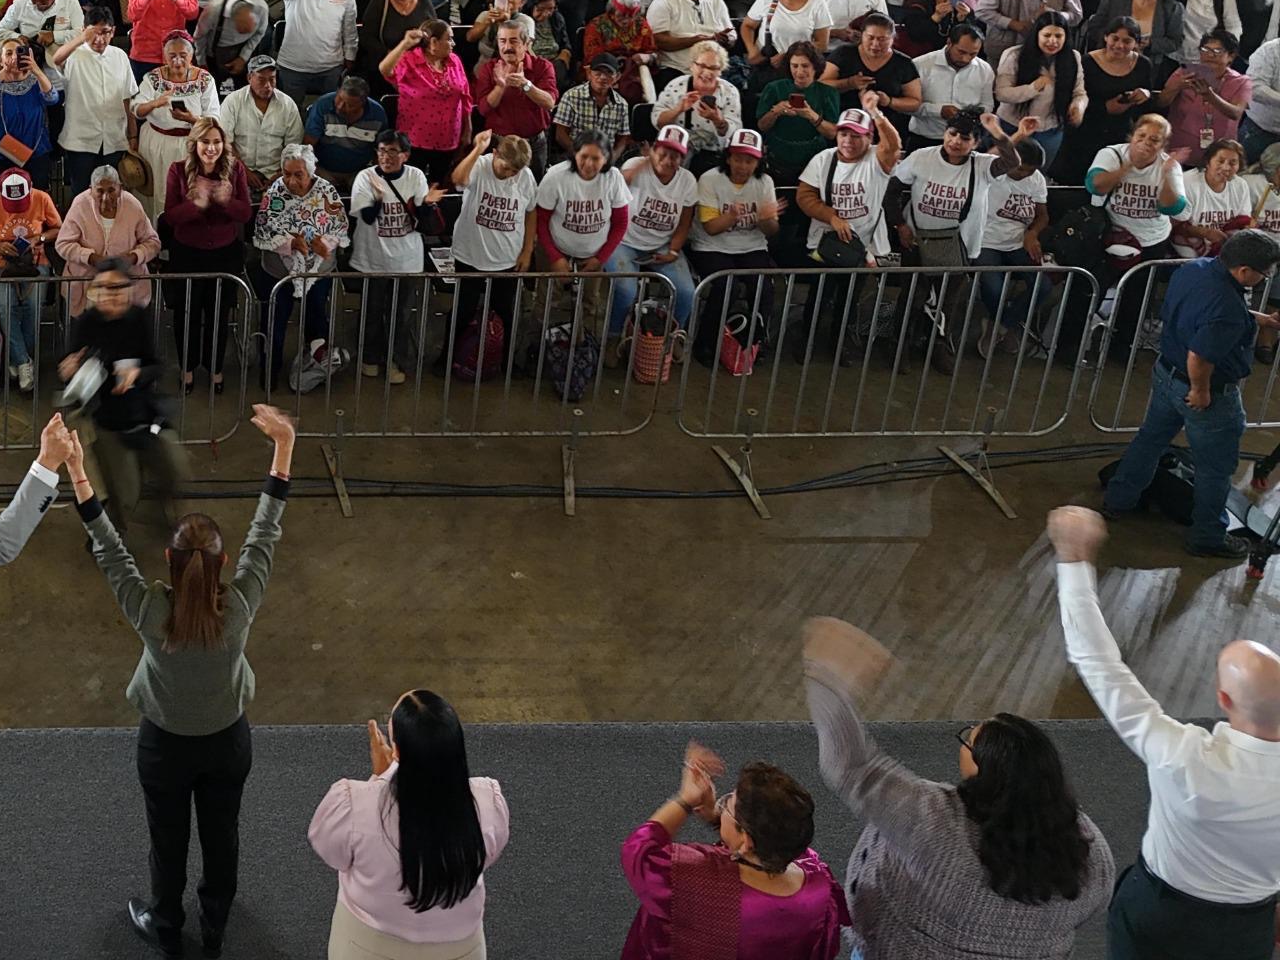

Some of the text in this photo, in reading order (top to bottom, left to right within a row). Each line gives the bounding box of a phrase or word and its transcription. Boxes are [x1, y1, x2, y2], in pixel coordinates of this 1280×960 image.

[832, 182, 866, 196] UEBLA
[925, 181, 967, 200] PUEBLA
[383, 202, 404, 214] UEB
[481, 191, 519, 211] PUEBLA
[566, 199, 604, 213] PUEBLA
[643, 196, 678, 214] PUEBLA
[832, 196, 865, 208] APITAL
[1115, 194, 1156, 209] CAPITA
[478, 205, 516, 222] CAPITAL
[639, 207, 676, 224] CAPITAL
[723, 202, 757, 215] PBLA
[378, 215, 410, 227] CAPITA
[565, 212, 605, 224] CAPITAL
